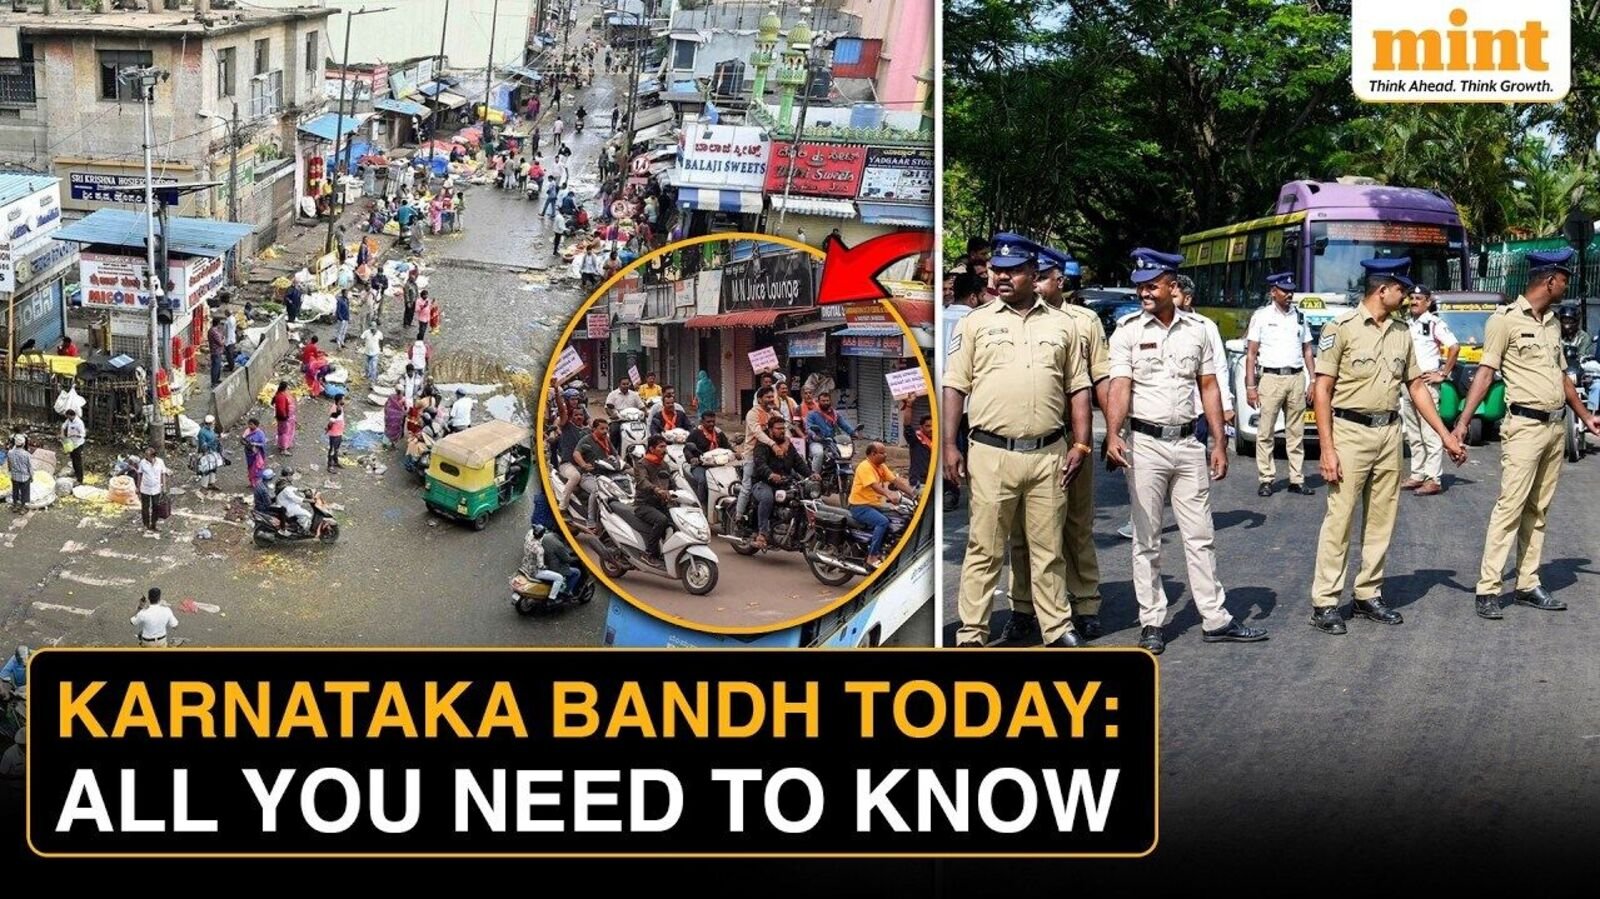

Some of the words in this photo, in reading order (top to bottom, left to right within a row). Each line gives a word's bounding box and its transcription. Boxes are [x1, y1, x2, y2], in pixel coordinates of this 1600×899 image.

[684, 159, 722, 173] BALAJI
[724, 160, 766, 175] SWEETS
[869, 155, 910, 166] YADGAAR
[71, 174, 83, 183] SRI
[84, 175, 116, 185] KRISHNA
[746, 276, 766, 302] Juice
[765, 274, 799, 305] Lounge
[88, 289, 135, 305] MICON
[1302, 301, 1322, 309] TAXI
